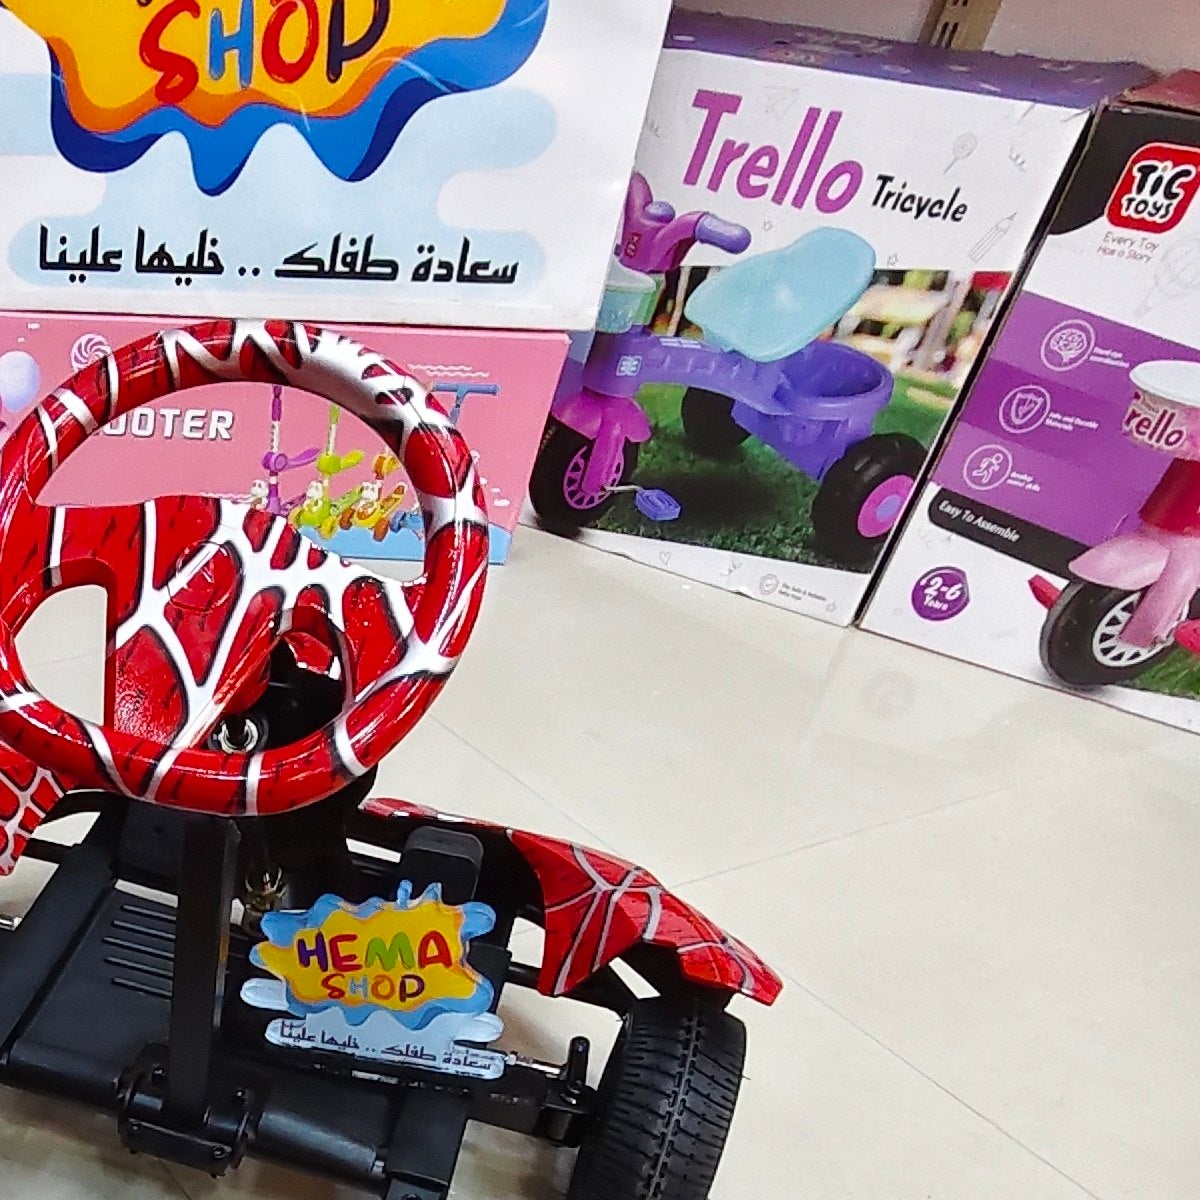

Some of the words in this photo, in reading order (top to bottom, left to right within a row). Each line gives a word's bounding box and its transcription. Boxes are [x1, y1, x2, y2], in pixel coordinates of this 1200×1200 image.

[140, 0, 390, 103] SHOP
[683, 89, 863, 213] Trello
[872, 174, 968, 221] Tricycle
[39, 224, 123, 284] علينا
[135, 226, 224, 287] خليها
[274, 232, 399, 281] طفلك
[411, 236, 519, 285] سعادة
[1125, 399, 1184, 447] rello
[938, 500, 961, 519] Easy
[962, 509, 974, 523] To
[974, 515, 1021, 543] Assemble
[298, 930, 452, 972] HEMA
[321, 973, 425, 1002] SHOP
[280, 1023, 317, 1043] علينا
[321, 1030, 360, 1050] خليها
[381, 1043, 437, 1062] طفلك
[442, 1051, 491, 1071] سعادة
